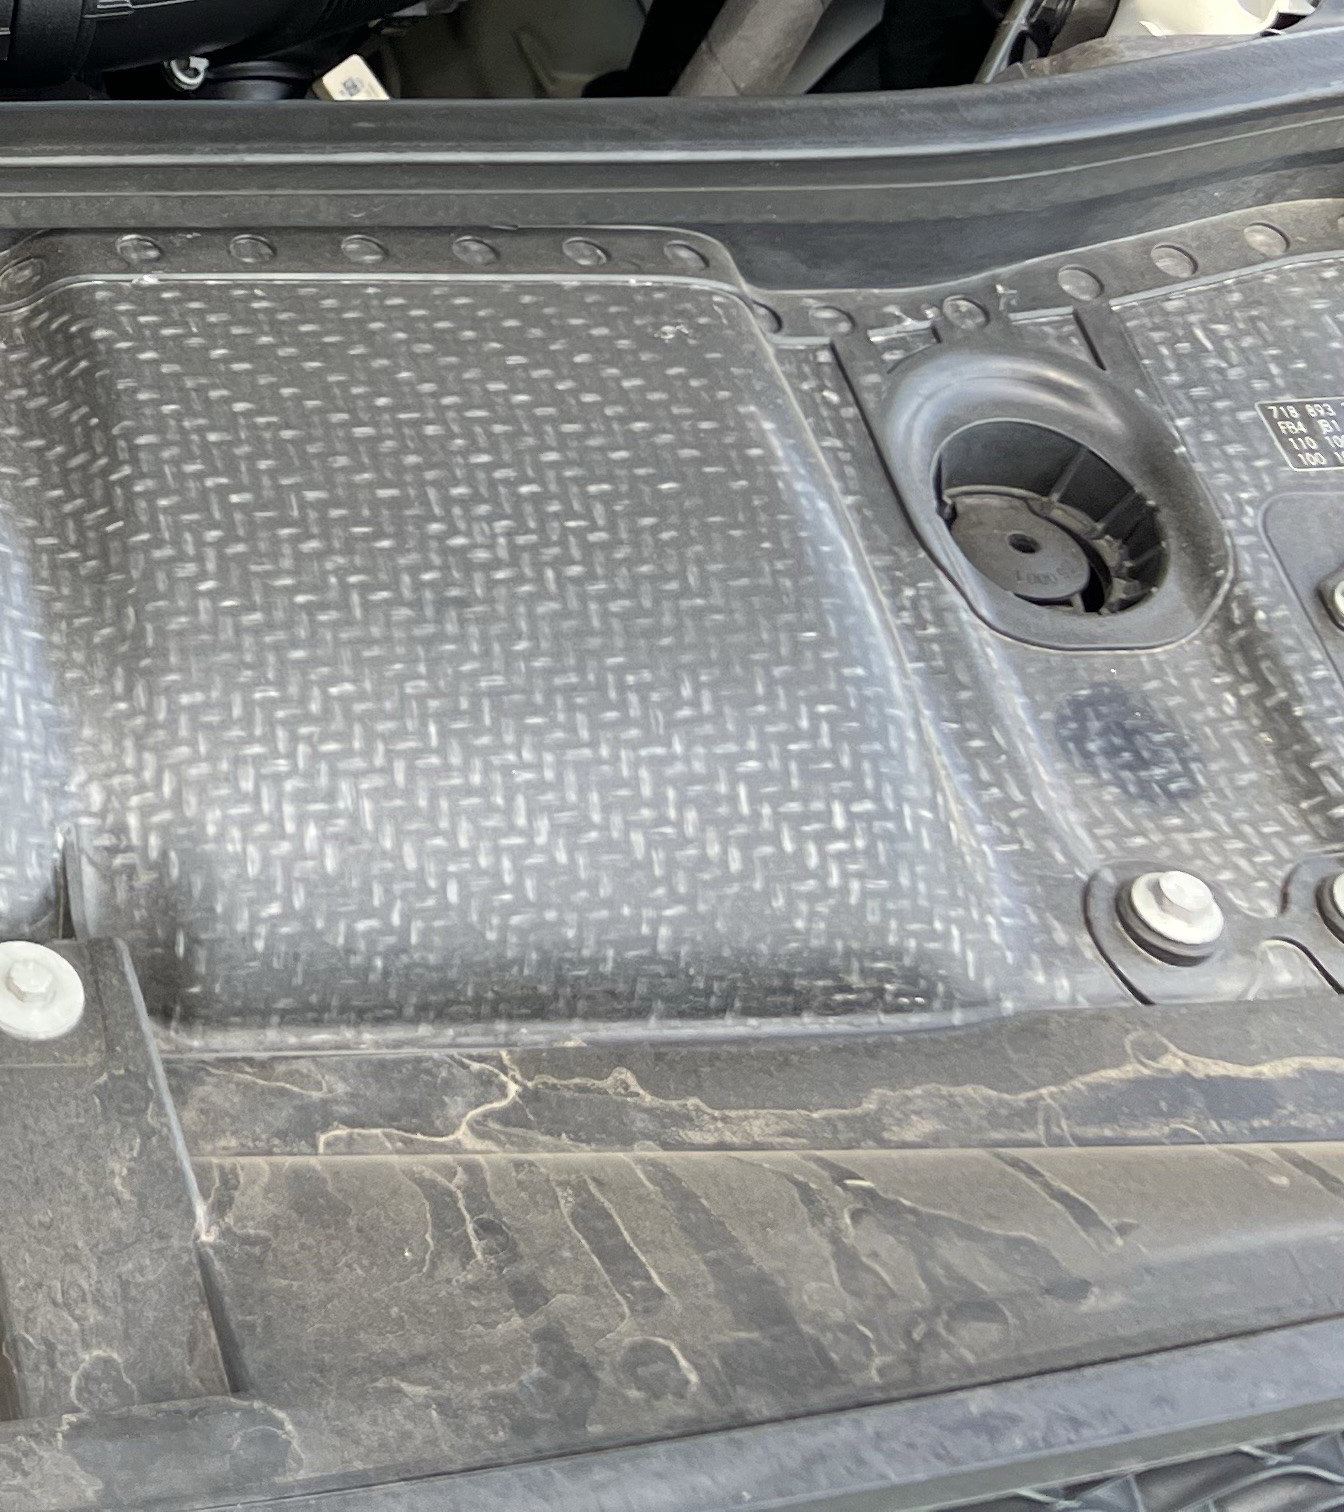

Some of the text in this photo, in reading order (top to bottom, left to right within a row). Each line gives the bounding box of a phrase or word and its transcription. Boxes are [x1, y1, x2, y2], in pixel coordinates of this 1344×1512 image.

[1267, 405, 1300, 419] 718
[1305, 403, 1336, 417] 893
[1288, 436, 1318, 450] 110
[1297, 452, 1327, 466] 100
